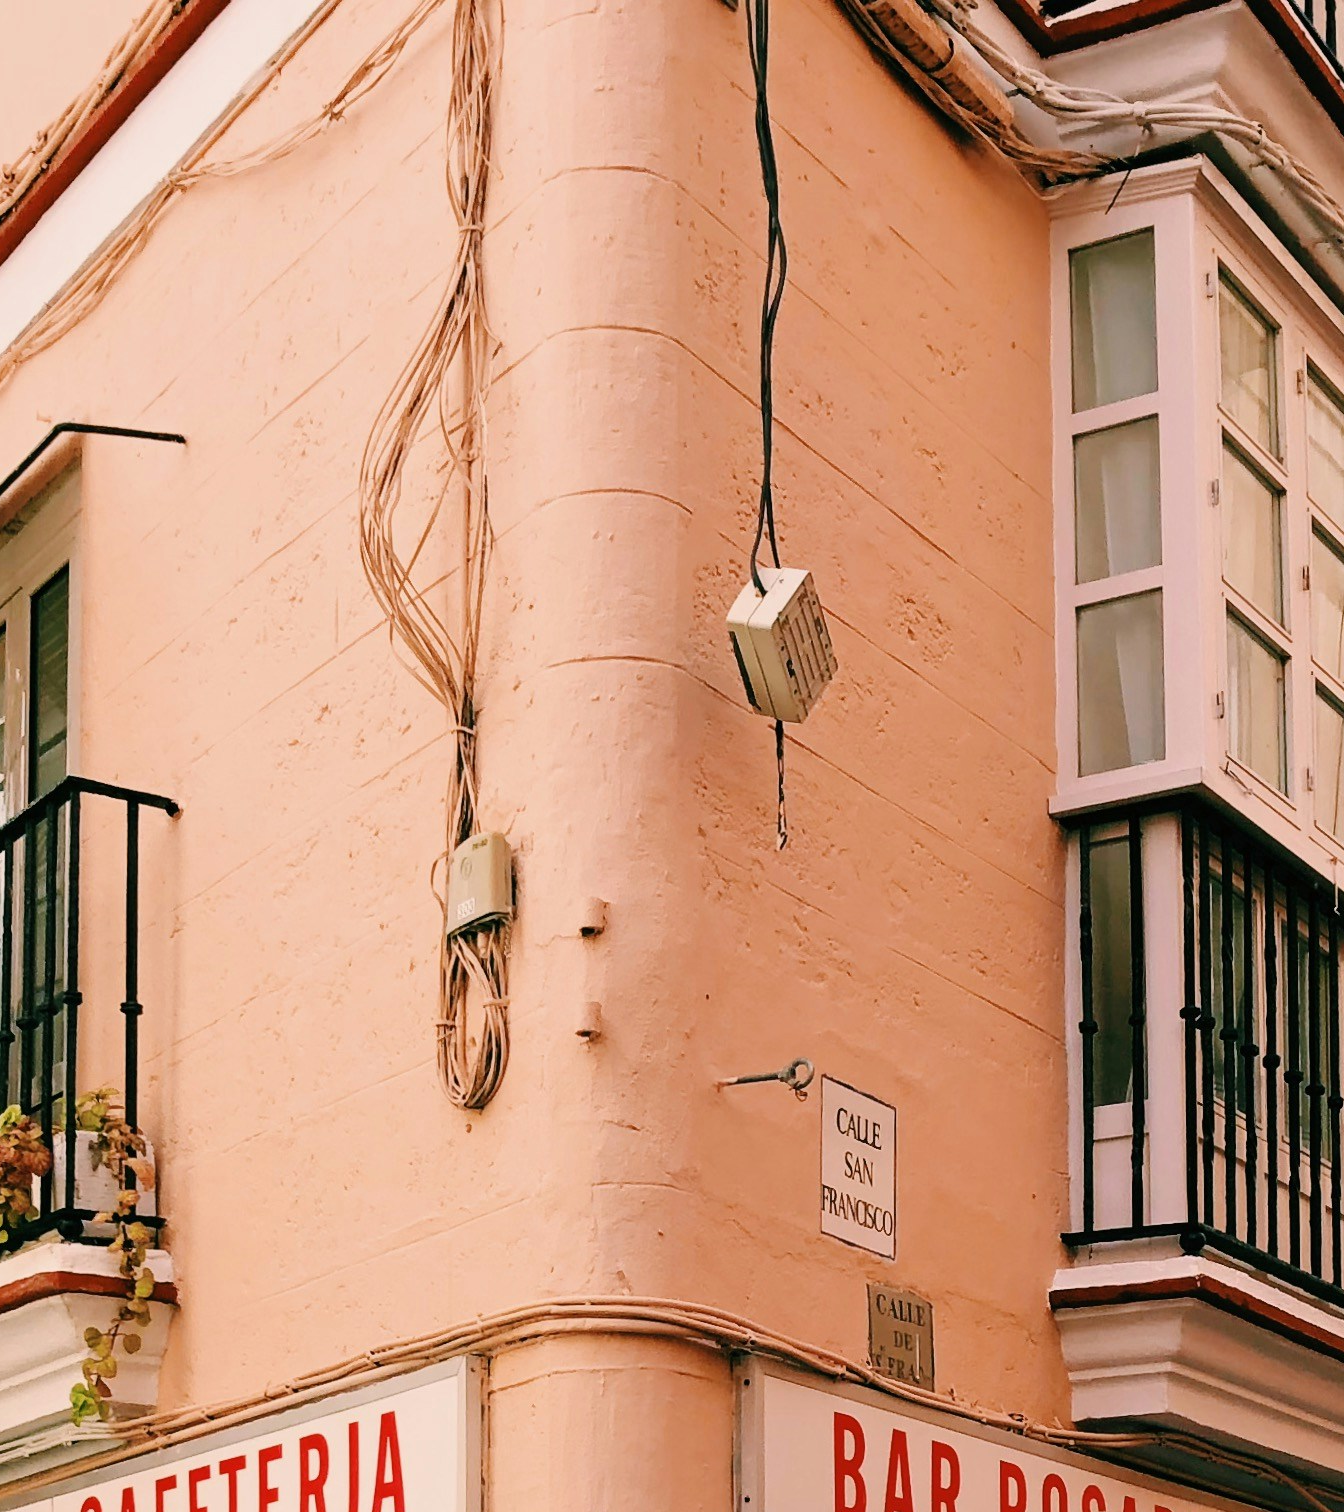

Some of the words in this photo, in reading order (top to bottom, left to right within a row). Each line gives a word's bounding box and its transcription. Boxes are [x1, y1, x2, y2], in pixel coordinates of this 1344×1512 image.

[835, 1106, 883, 1151] CALLE
[844, 1151, 874, 1188] SAN
[821, 1183, 894, 1238] FRANCISCO
[875, 1292, 926, 1328] CALLE
[893, 1330, 914, 1352] DE
